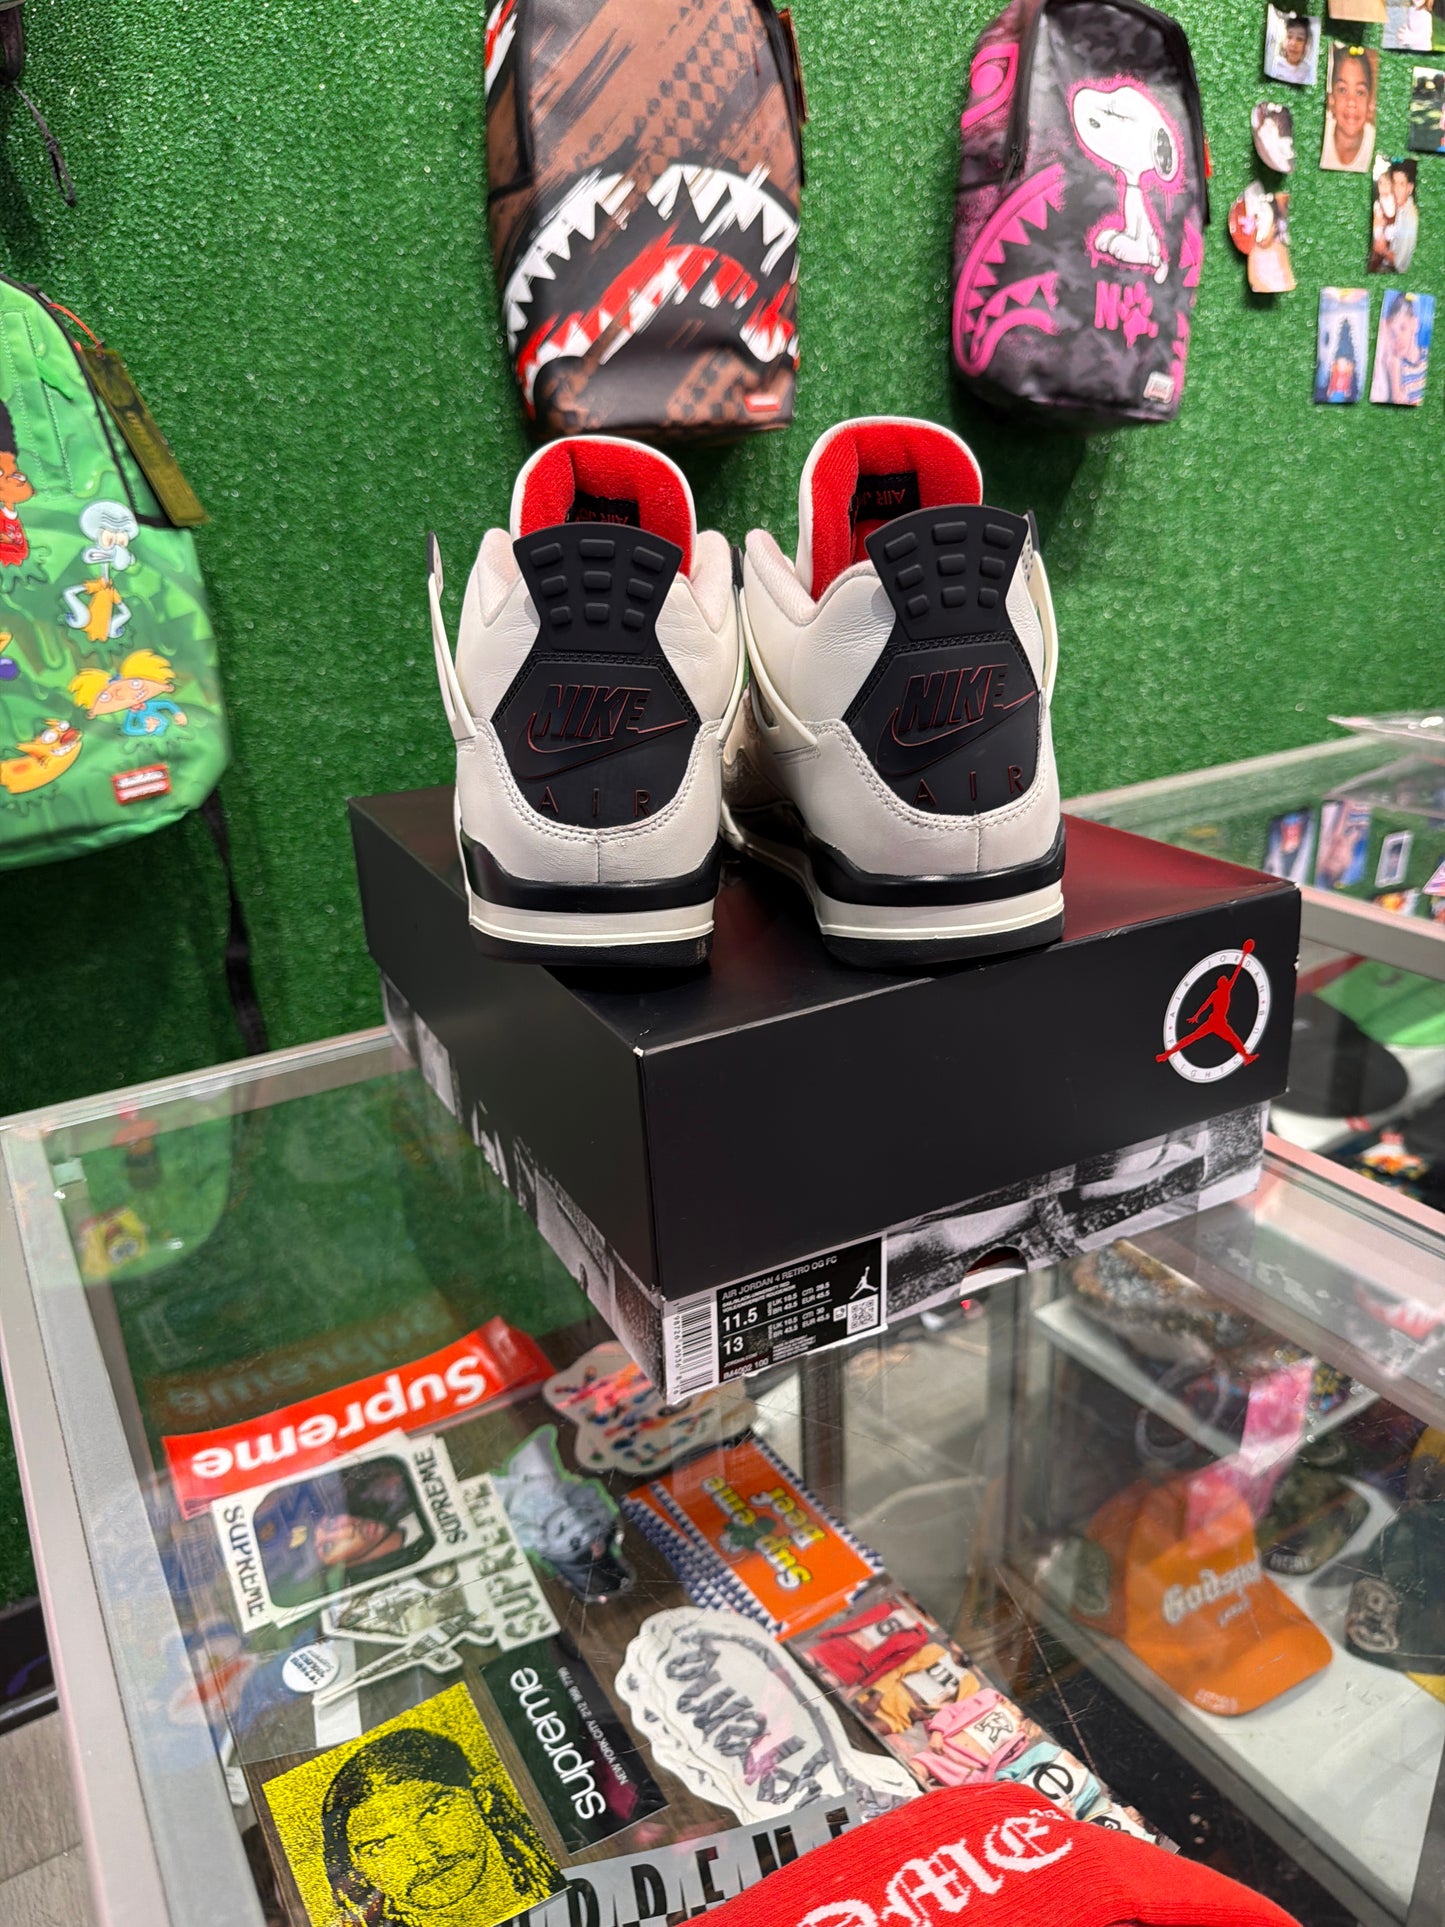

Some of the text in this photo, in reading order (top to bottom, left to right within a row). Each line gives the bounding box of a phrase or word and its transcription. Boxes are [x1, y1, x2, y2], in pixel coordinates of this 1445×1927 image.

[534, 684, 652, 739] NIKE
[897, 664, 1009, 733] NIKE
[536, 785, 651, 818] AIR
[912, 764, 1025, 807] AIR
[722, 1255, 838, 1301] AIR JORDAN 4 RETRO OG FC
[722, 1306, 759, 1332] 11.5
[722, 1335, 745, 1356] 13
[753, 1357, 769, 1369] 100
[192, 1355, 487, 1478] Supreme
[414, 1446, 467, 1546] SUPREME
[223, 1504, 267, 1619] SUPREME
[510, 1667, 607, 1820] supreme
[586, 1719, 604, 1743] CITY
[598, 1739, 618, 1764] YORK
[612, 1761, 631, 1786] NEW
